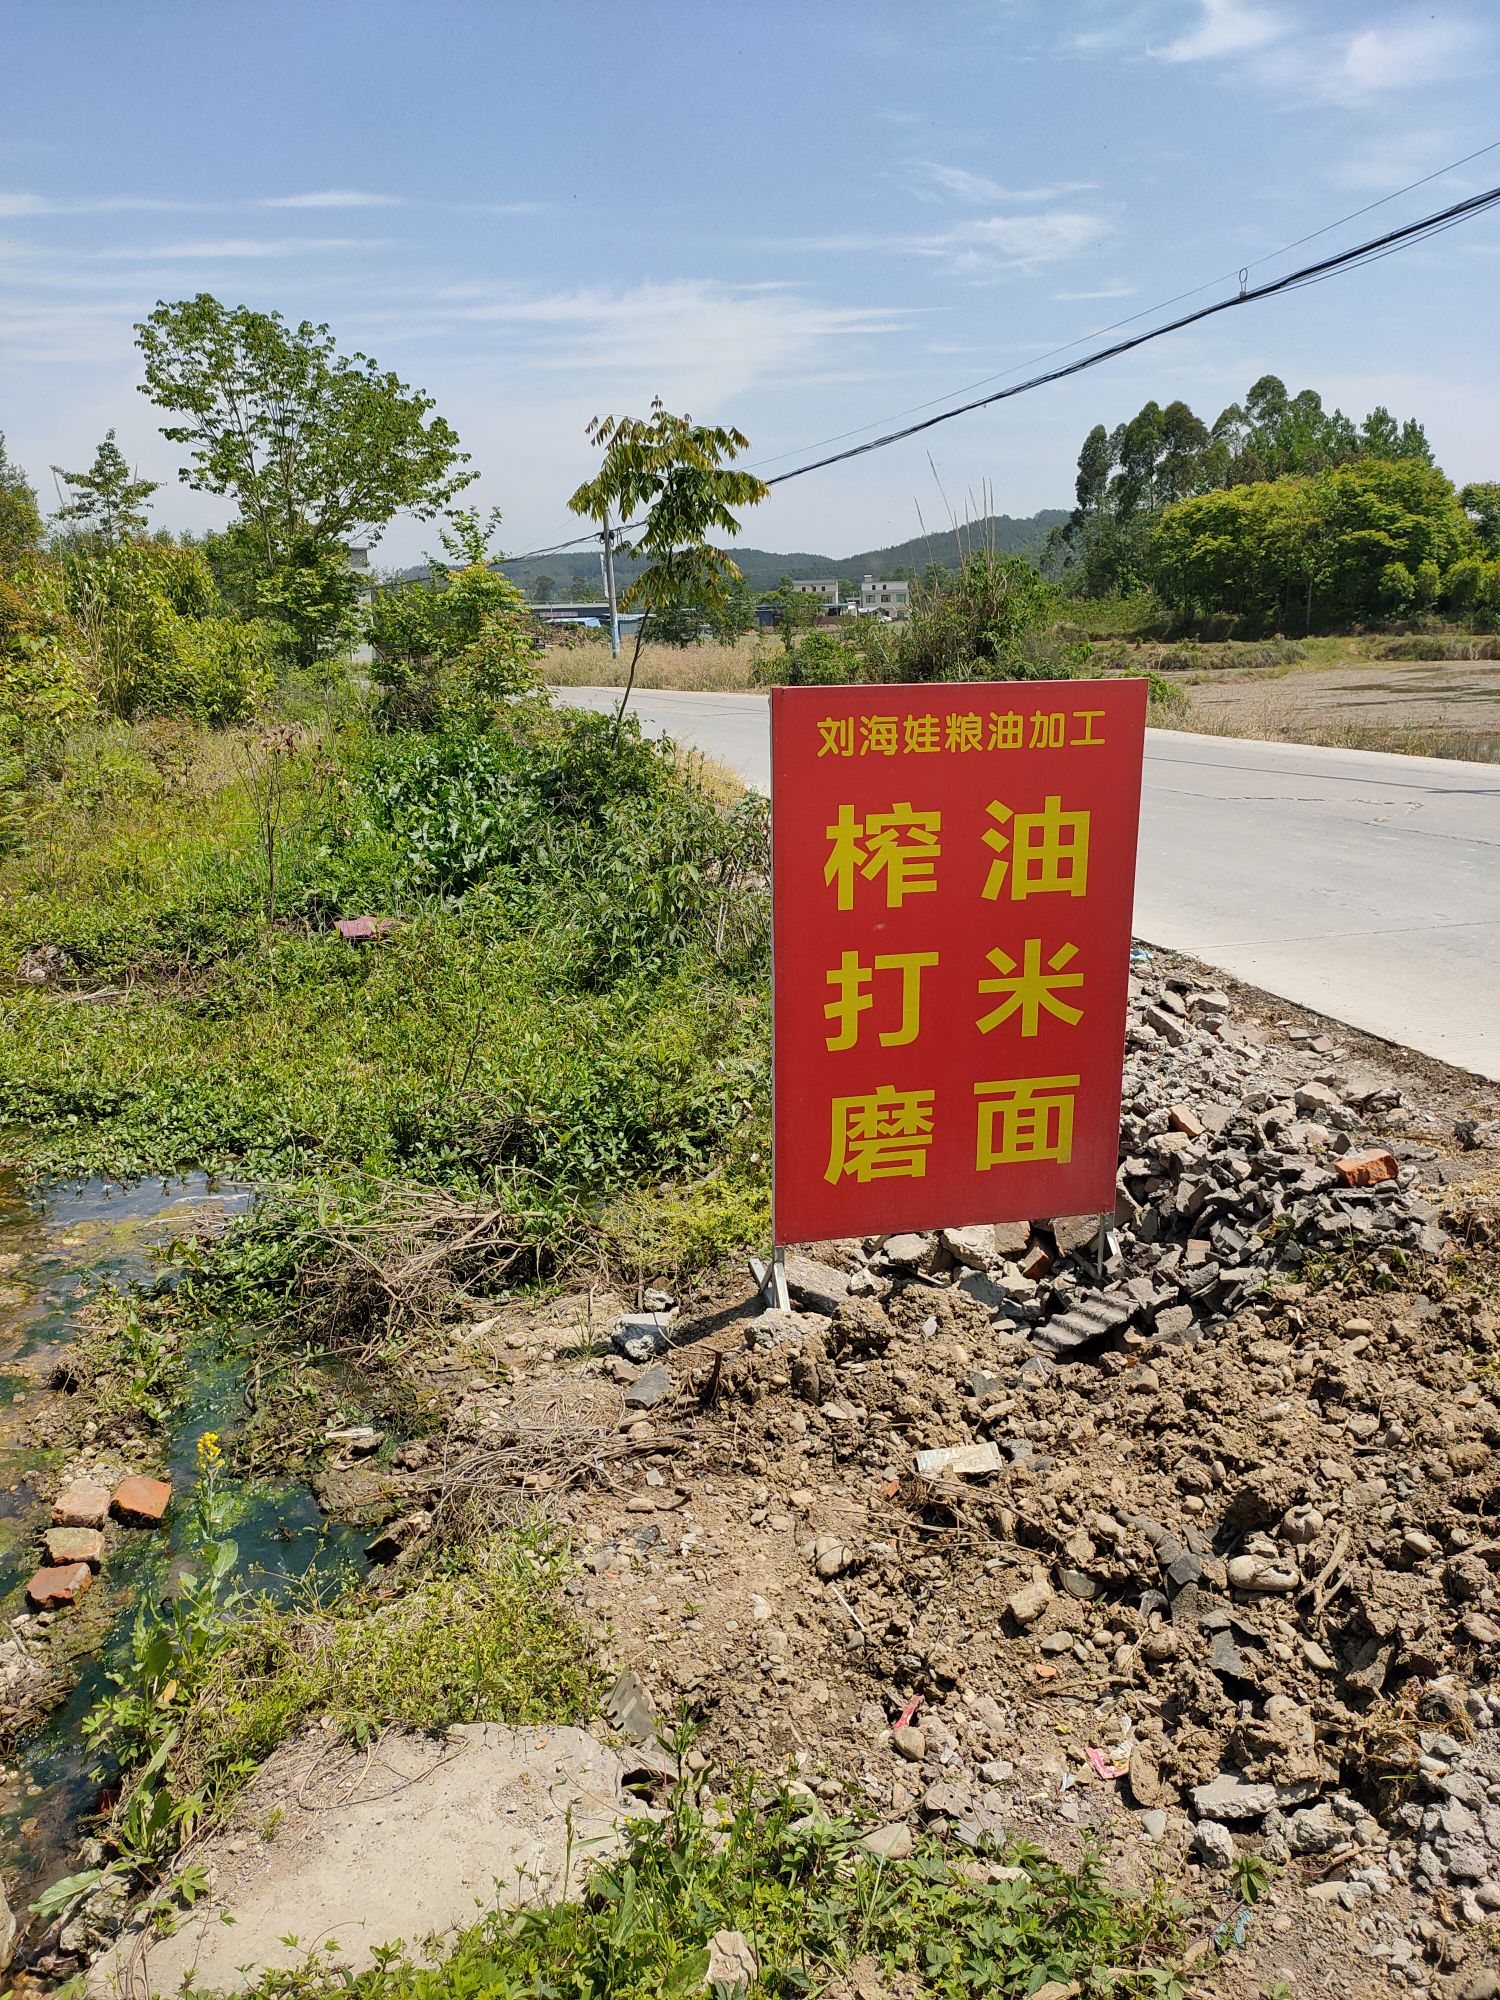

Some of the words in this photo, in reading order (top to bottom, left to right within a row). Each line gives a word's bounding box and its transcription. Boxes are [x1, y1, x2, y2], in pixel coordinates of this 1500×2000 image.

[817, 710, 1106, 757] 刘海娃粮油加工
